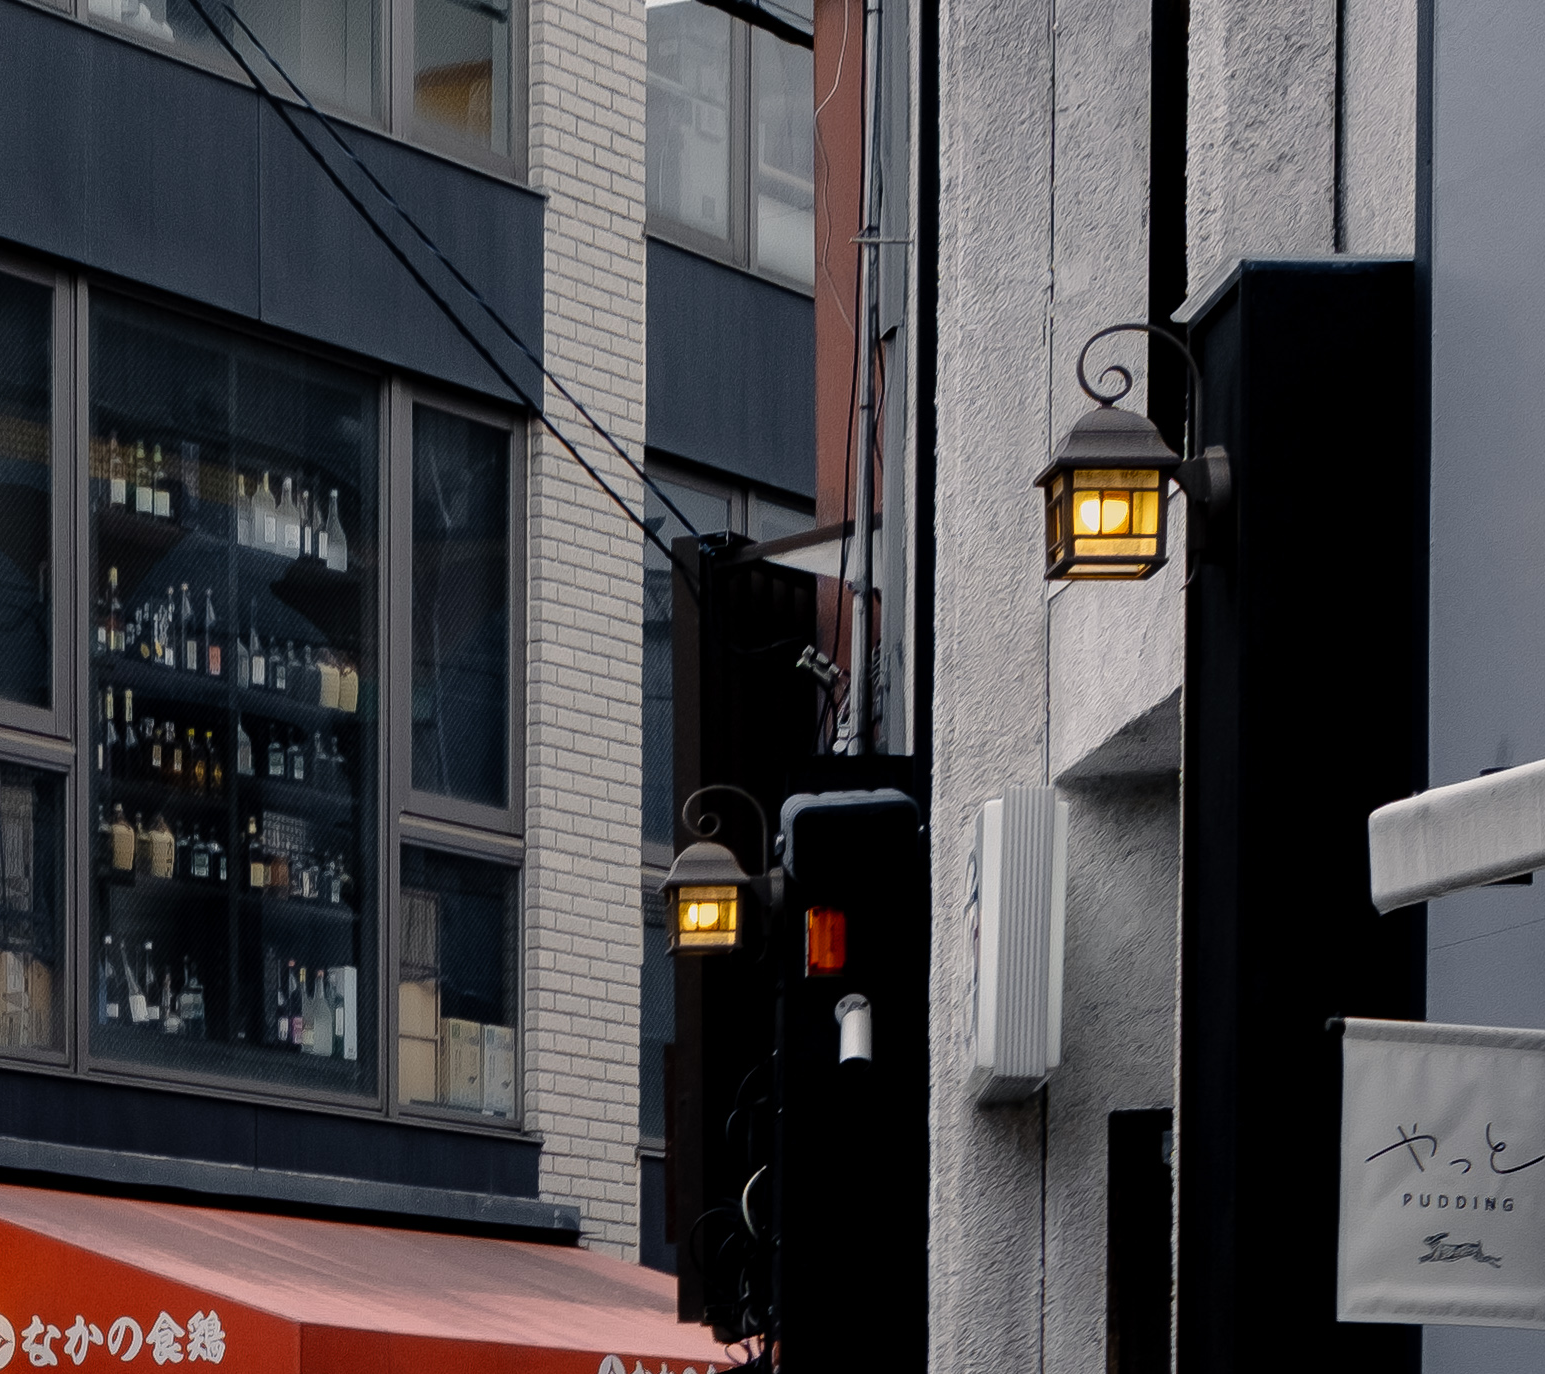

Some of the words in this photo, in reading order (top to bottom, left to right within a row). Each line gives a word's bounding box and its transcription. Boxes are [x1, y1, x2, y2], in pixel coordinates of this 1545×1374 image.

[1402, 1192, 1515, 1213] PUDDING
[20, 1309, 226, 1368] なかの食鶏
